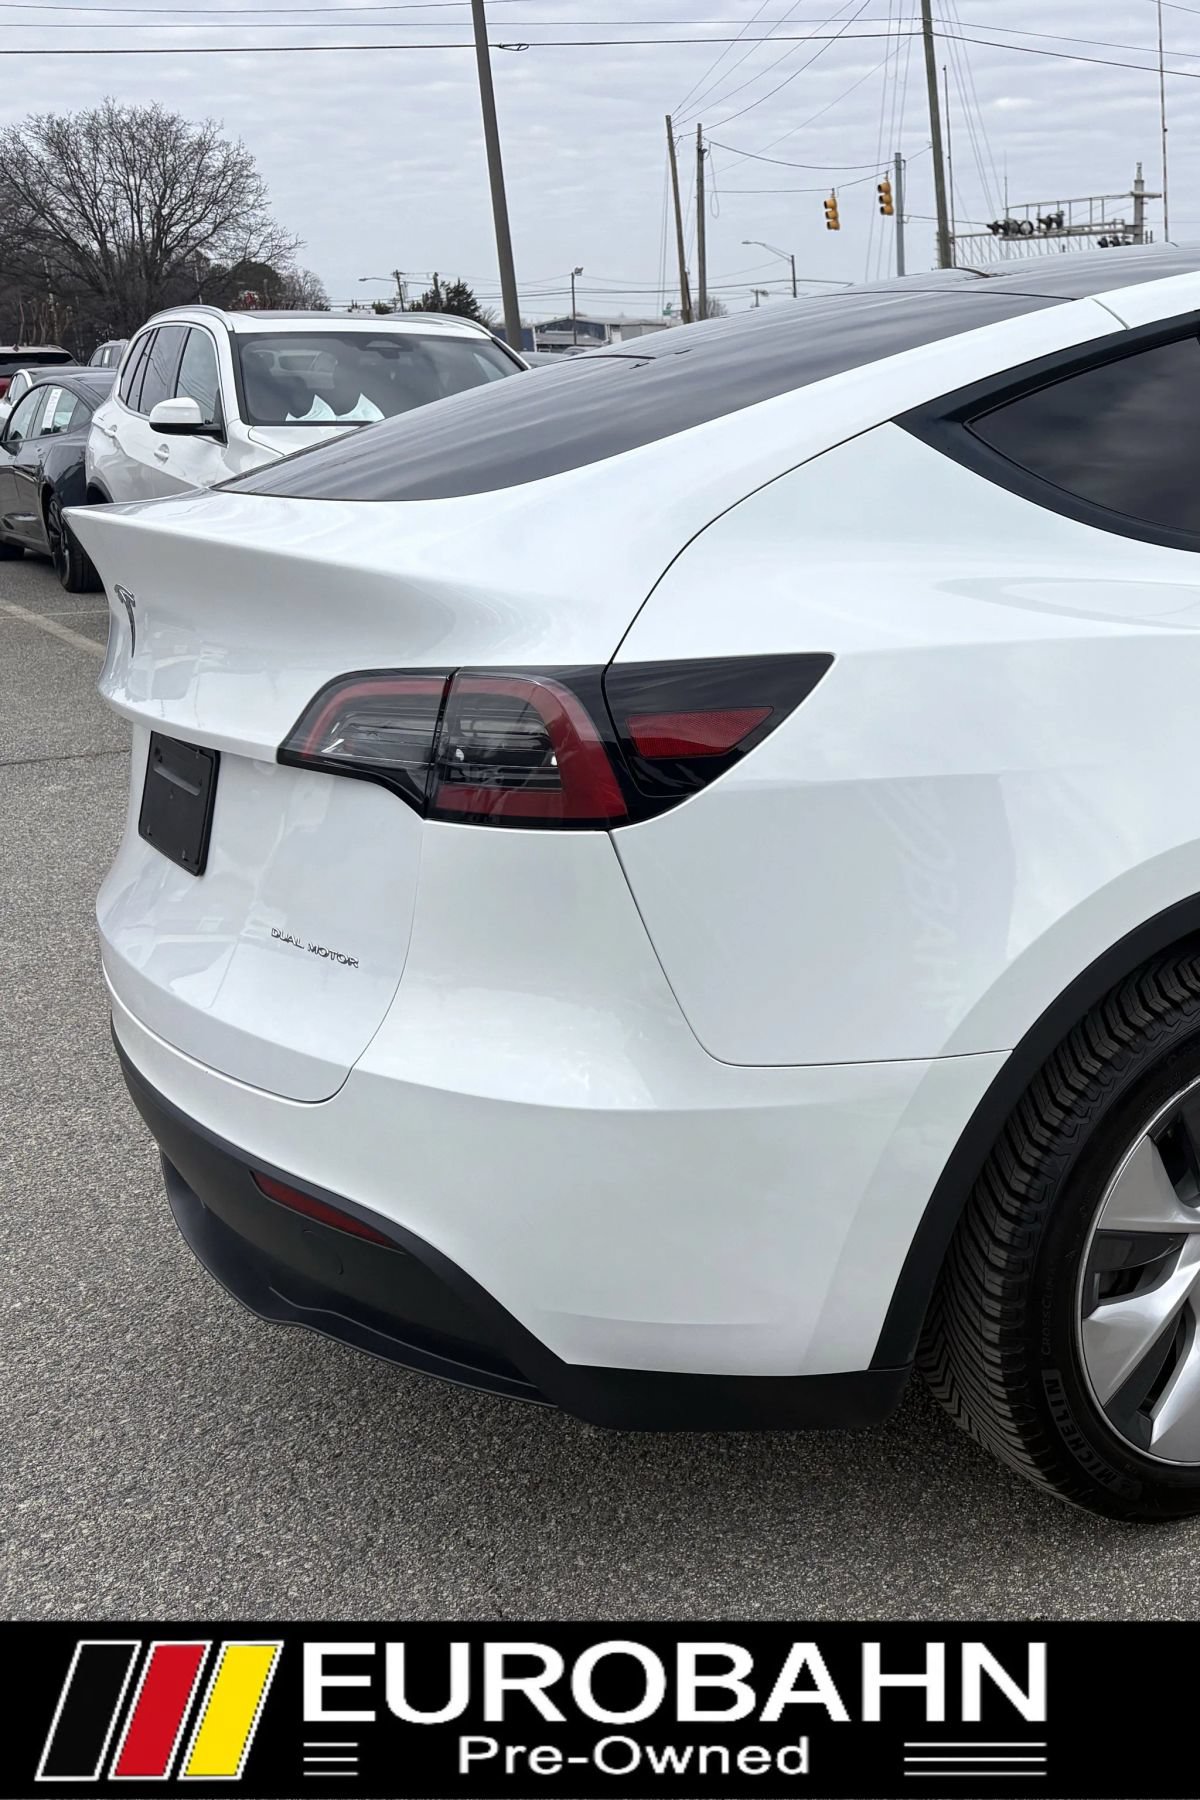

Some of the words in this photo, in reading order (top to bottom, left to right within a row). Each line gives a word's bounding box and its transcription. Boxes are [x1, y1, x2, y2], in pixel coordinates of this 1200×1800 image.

[271, 928, 304, 949] DUAL
[307, 943, 359, 968] MOTOR
[1039, 1259, 1056, 1356] CROSSCLIMA
[1044, 1378, 1118, 1485] MICHELIN
